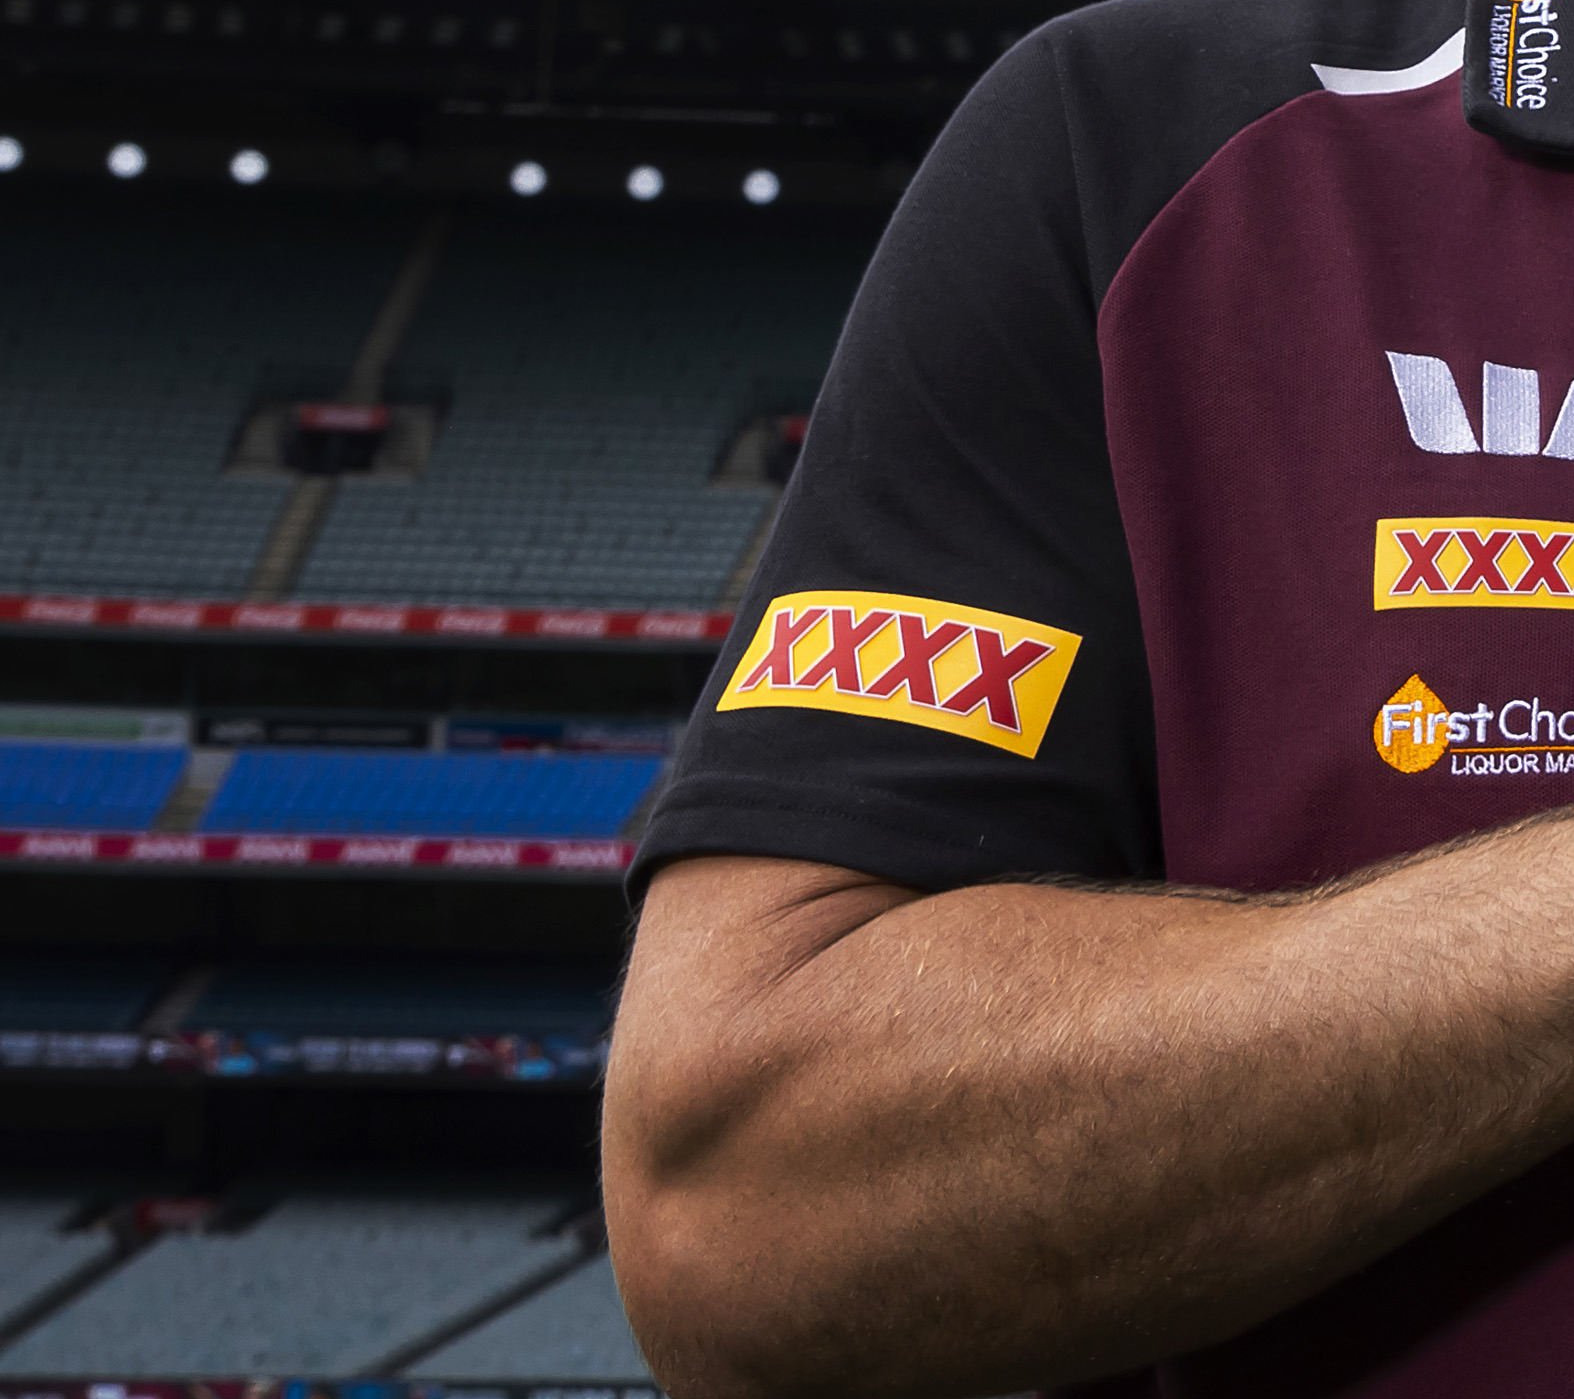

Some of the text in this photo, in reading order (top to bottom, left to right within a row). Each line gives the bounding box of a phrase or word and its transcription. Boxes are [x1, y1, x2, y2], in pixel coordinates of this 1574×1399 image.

[1489, 5, 1511, 57] LIQUOR
[1516, 28, 1561, 111] Choice
[735, 606, 1056, 733] XXXX
[1381, 700, 1494, 747] First
[1451, 754, 1540, 775] LIQUOR
